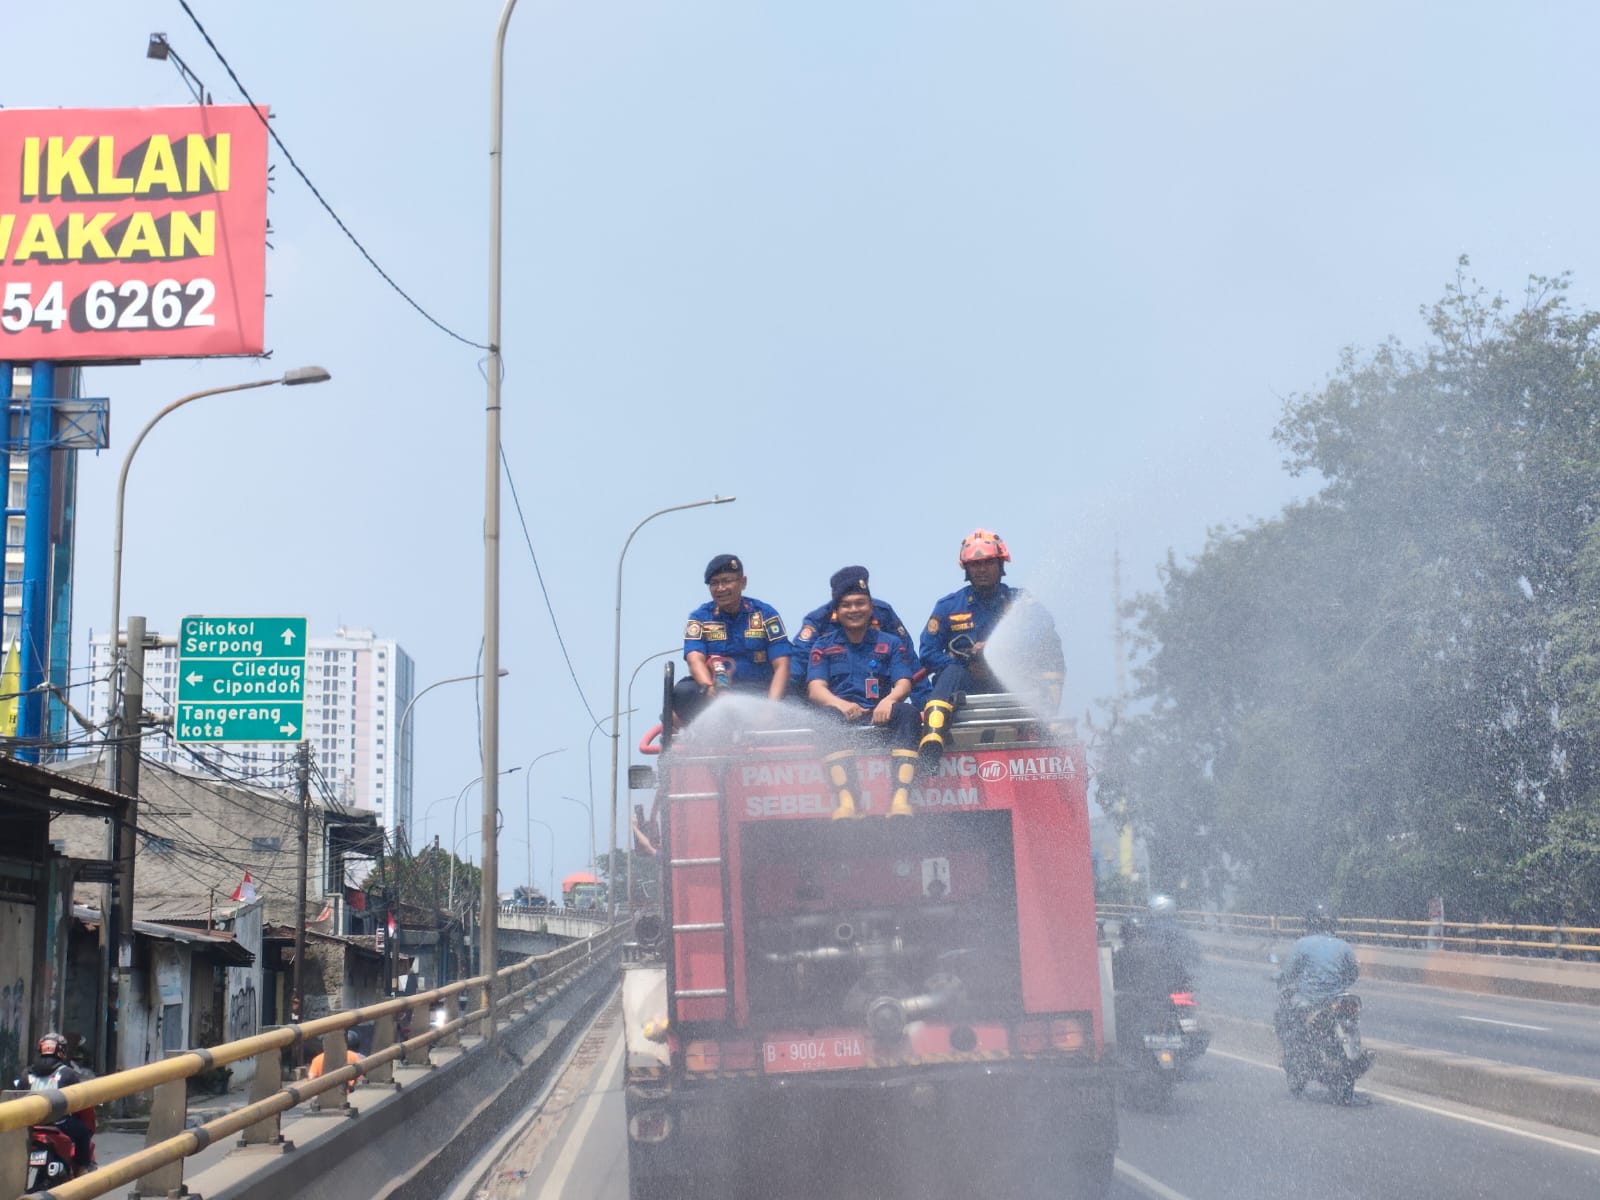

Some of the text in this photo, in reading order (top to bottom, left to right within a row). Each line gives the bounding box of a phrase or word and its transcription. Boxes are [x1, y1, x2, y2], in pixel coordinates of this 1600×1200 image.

[22, 132, 231, 196] IKLAN
[0, 209, 216, 261] AKAN
[1, 277, 216, 331] 54 6262
[186, 621, 254, 636] Cikokol
[185, 638, 263, 656] Serpong
[232, 662, 301, 680] Ciledug
[213, 679, 300, 697] Cipondoh
[182, 705, 281, 725] Tangerang
[181, 723, 224, 737] kota
[1008, 756, 1076, 774] MATRA
[909, 787, 981, 807] ADAM
[767, 1039, 862, 1062] B 9004 CHA
